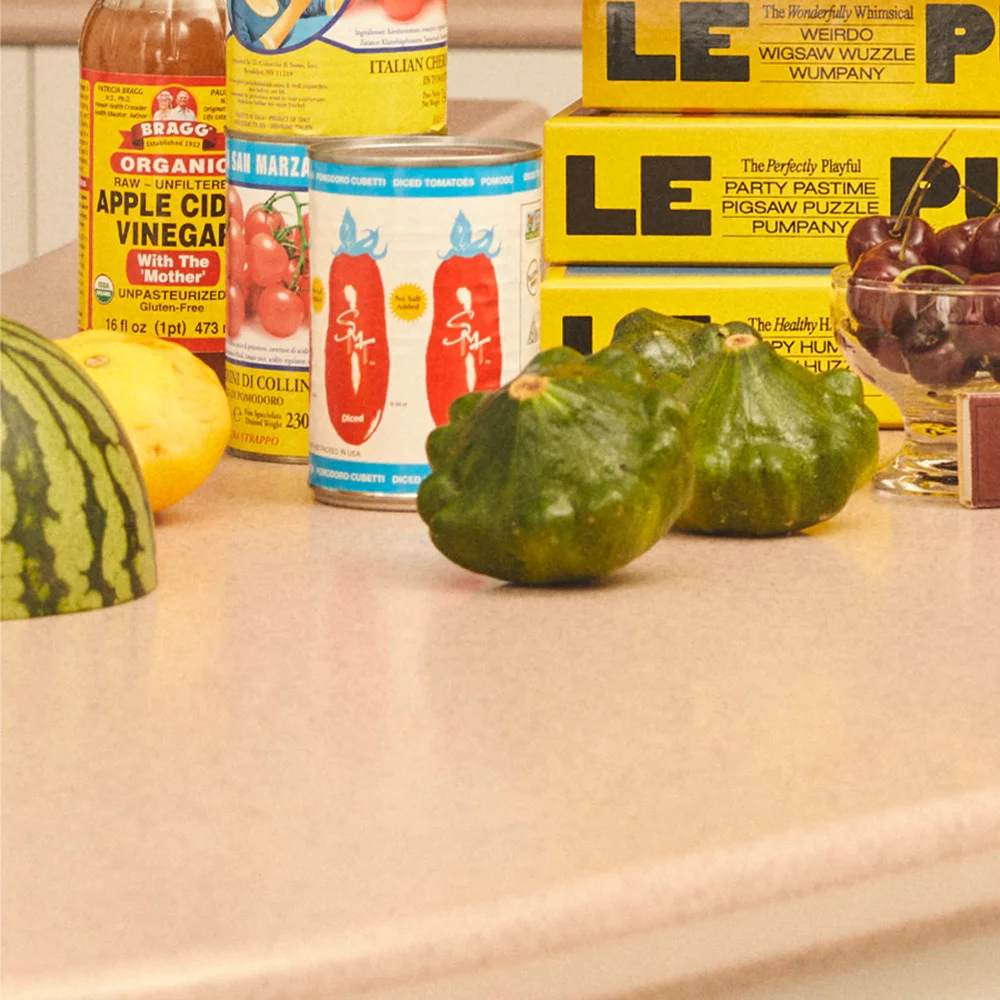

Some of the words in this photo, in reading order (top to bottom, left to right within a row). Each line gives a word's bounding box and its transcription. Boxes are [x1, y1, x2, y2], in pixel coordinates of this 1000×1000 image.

[763, 4, 785, 19] The
[787, 4, 852, 24] Wonderfully
[854, 5, 914, 20] Whimsical
[606, 1, 750, 82] LE
[800, 28, 873, 41] WEIRDO
[759, 47, 834, 60] WIGSAW
[839, 48, 915, 61] WUZZLE
[369, 57, 423, 74] ITALIAN
[789, 67, 884, 80] WUMPANY
[141, 122, 209, 137] BRAGG
[120, 156, 226, 174] ORGANIC
[232, 150, 251, 173] SAN
[256, 154, 309, 177] MARZA
[741, 159, 764, 173] The
[766, 159, 817, 176] Perfectly
[822, 159, 861, 175] Playful
[114, 177, 140, 188] RAW
[155, 180, 226, 190] UNFILTERE
[350, 175, 386, 187] CUBETTI
[393, 178, 422, 188] DICED
[424, 177, 475, 188] TOMATOES
[725, 182, 787, 194] PARTY
[793, 183, 876, 195] PASTIME
[566, 155, 711, 236] LE
[96, 190, 171, 217] APPLE
[181, 193, 226, 219] CID
[722, 201, 798, 214] PIGSAW
[803, 202, 879, 214] PUZZLE
[752, 221, 849, 234] PUMPANY
[137, 253, 173, 267] With
[179, 255, 210, 268] The
[141, 269, 206, 284] 'Mother'
[118, 288, 226, 301] UNPASTEURIZED
[139, 302, 205, 312] Gluten-Free
[106, 318, 117, 331] 16
[120, 320, 128, 332] fl
[131, 323, 147, 333] oz
[155, 320, 187, 336] (1pt)
[194, 322, 219, 334] 473
[749, 317, 771, 331] The
[774, 317, 817, 335] Healthy
[242, 373, 253, 388] DI
[256, 375, 309, 392] COLLIN
[286, 412, 309, 429] 230
[341, 414, 364, 423] Diced
[241, 432, 279, 446] STRAPPO
[350, 472, 385, 483] CUBETTI
[392, 475, 421, 484] DICED
